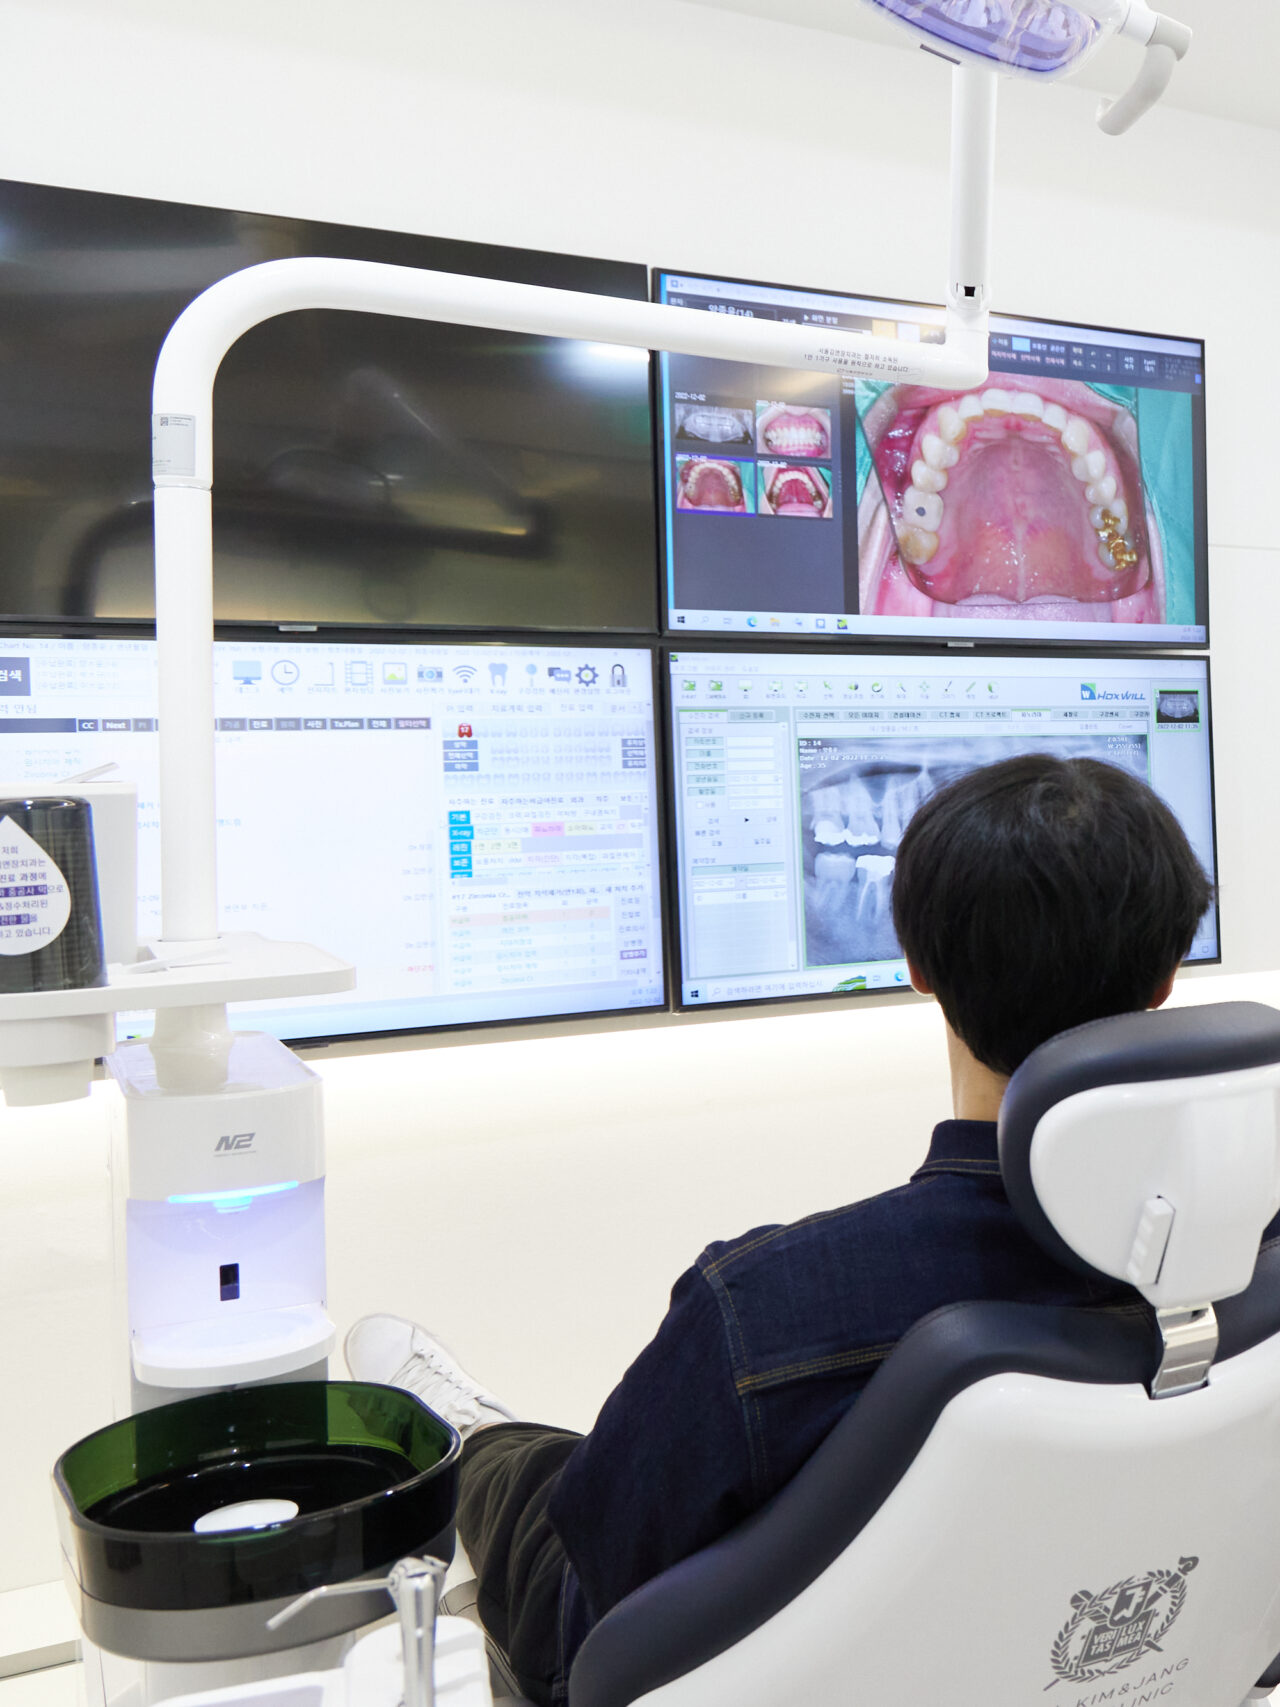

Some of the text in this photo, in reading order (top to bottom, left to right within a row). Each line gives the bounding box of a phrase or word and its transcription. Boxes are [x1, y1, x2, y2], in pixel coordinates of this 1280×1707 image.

[81, 722, 95, 730] CC
[105, 721, 126, 730] Next
[20, 872, 47, 883] 과정에
[213, 1132, 256, 1152] N2
